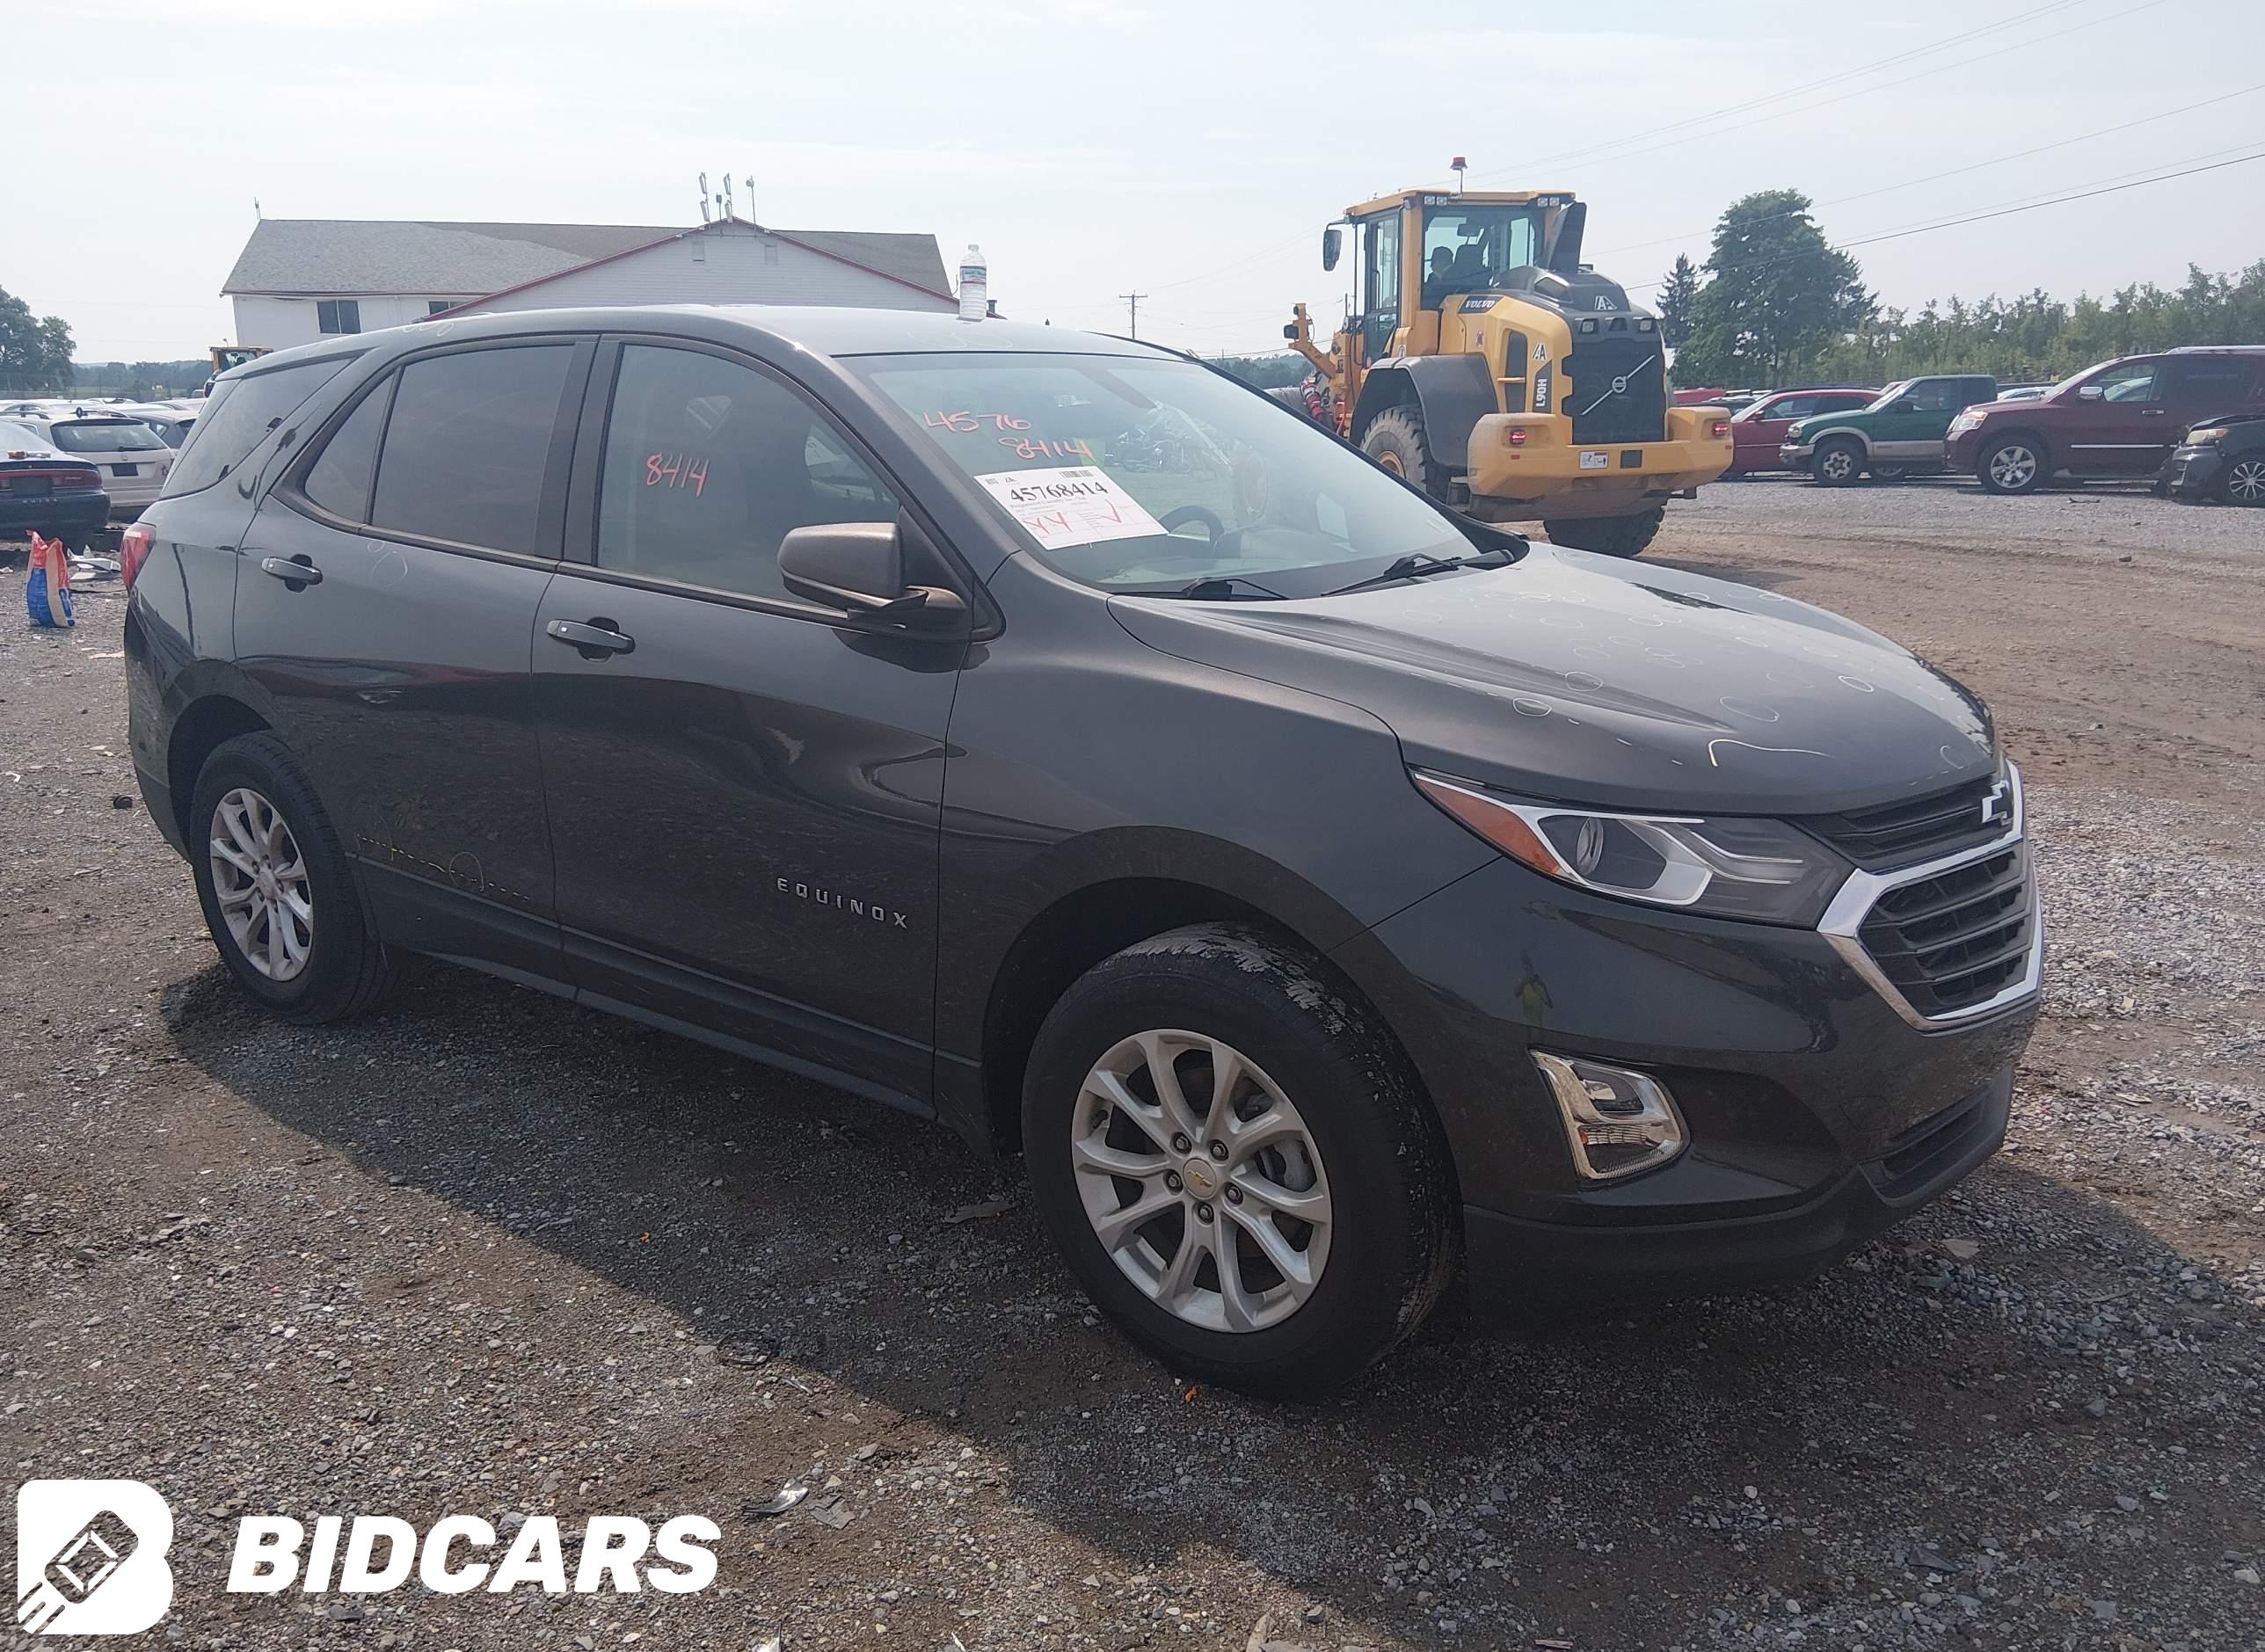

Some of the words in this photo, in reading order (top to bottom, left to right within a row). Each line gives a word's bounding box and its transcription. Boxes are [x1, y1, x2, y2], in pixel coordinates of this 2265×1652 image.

[1465, 300, 1496, 309] VOLVO
[1535, 378, 1548, 407] L90H
[999, 437, 1097, 462] 8414
[646, 450, 710, 498] 8414
[1010, 482, 1109, 503] 45768414
[776, 877, 908, 929] EQUINOX
